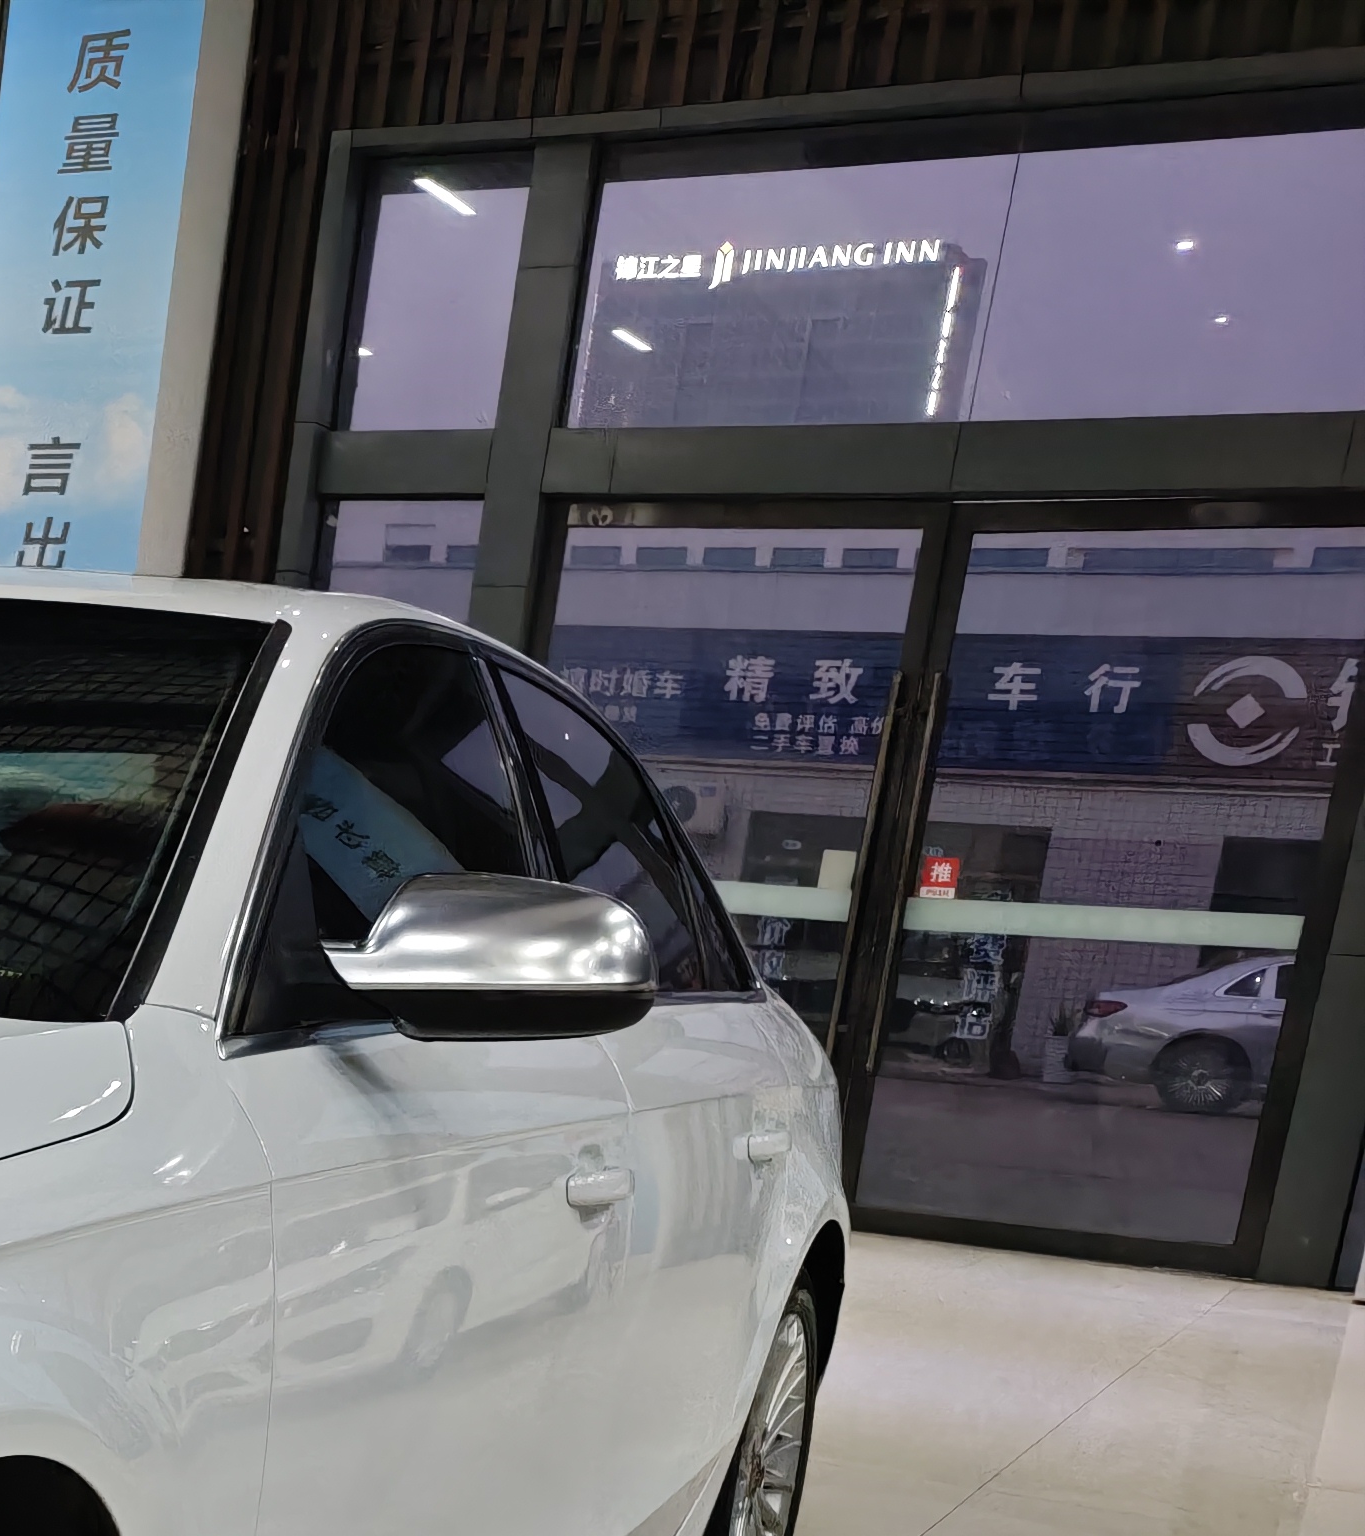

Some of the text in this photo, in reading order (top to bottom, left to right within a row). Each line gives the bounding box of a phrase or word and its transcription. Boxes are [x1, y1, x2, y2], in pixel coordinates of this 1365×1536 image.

[615, 253, 703, 281] 锦江之星
[740, 239, 942, 275] JINJIANG INN
[15, 28, 131, 567] 质量保证 言出
[929, 861, 953, 883] 推
